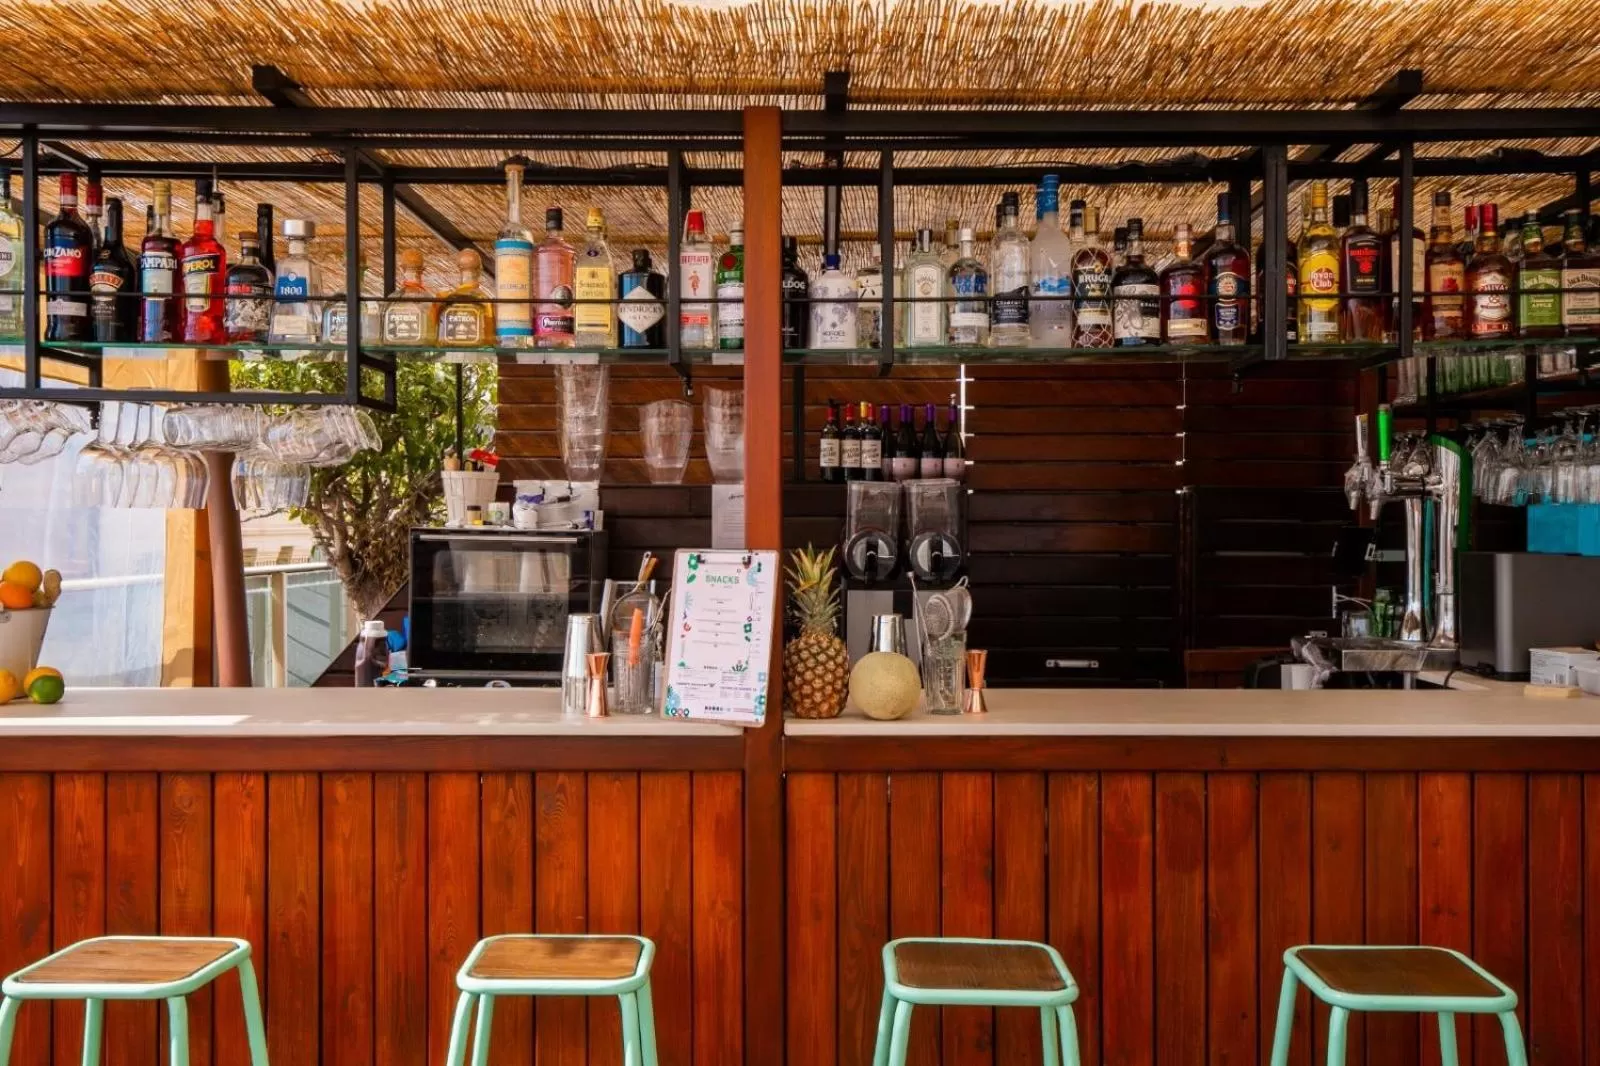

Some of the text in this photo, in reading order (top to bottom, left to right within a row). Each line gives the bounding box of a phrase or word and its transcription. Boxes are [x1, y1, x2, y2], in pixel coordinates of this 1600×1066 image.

[44, 246, 82, 259] CINZANO
[141, 257, 177, 269] AMPARI
[782, 280, 806, 289] LDOG
[280, 286, 302, 295] 1800
[706, 575, 739, 584] SNACKS
